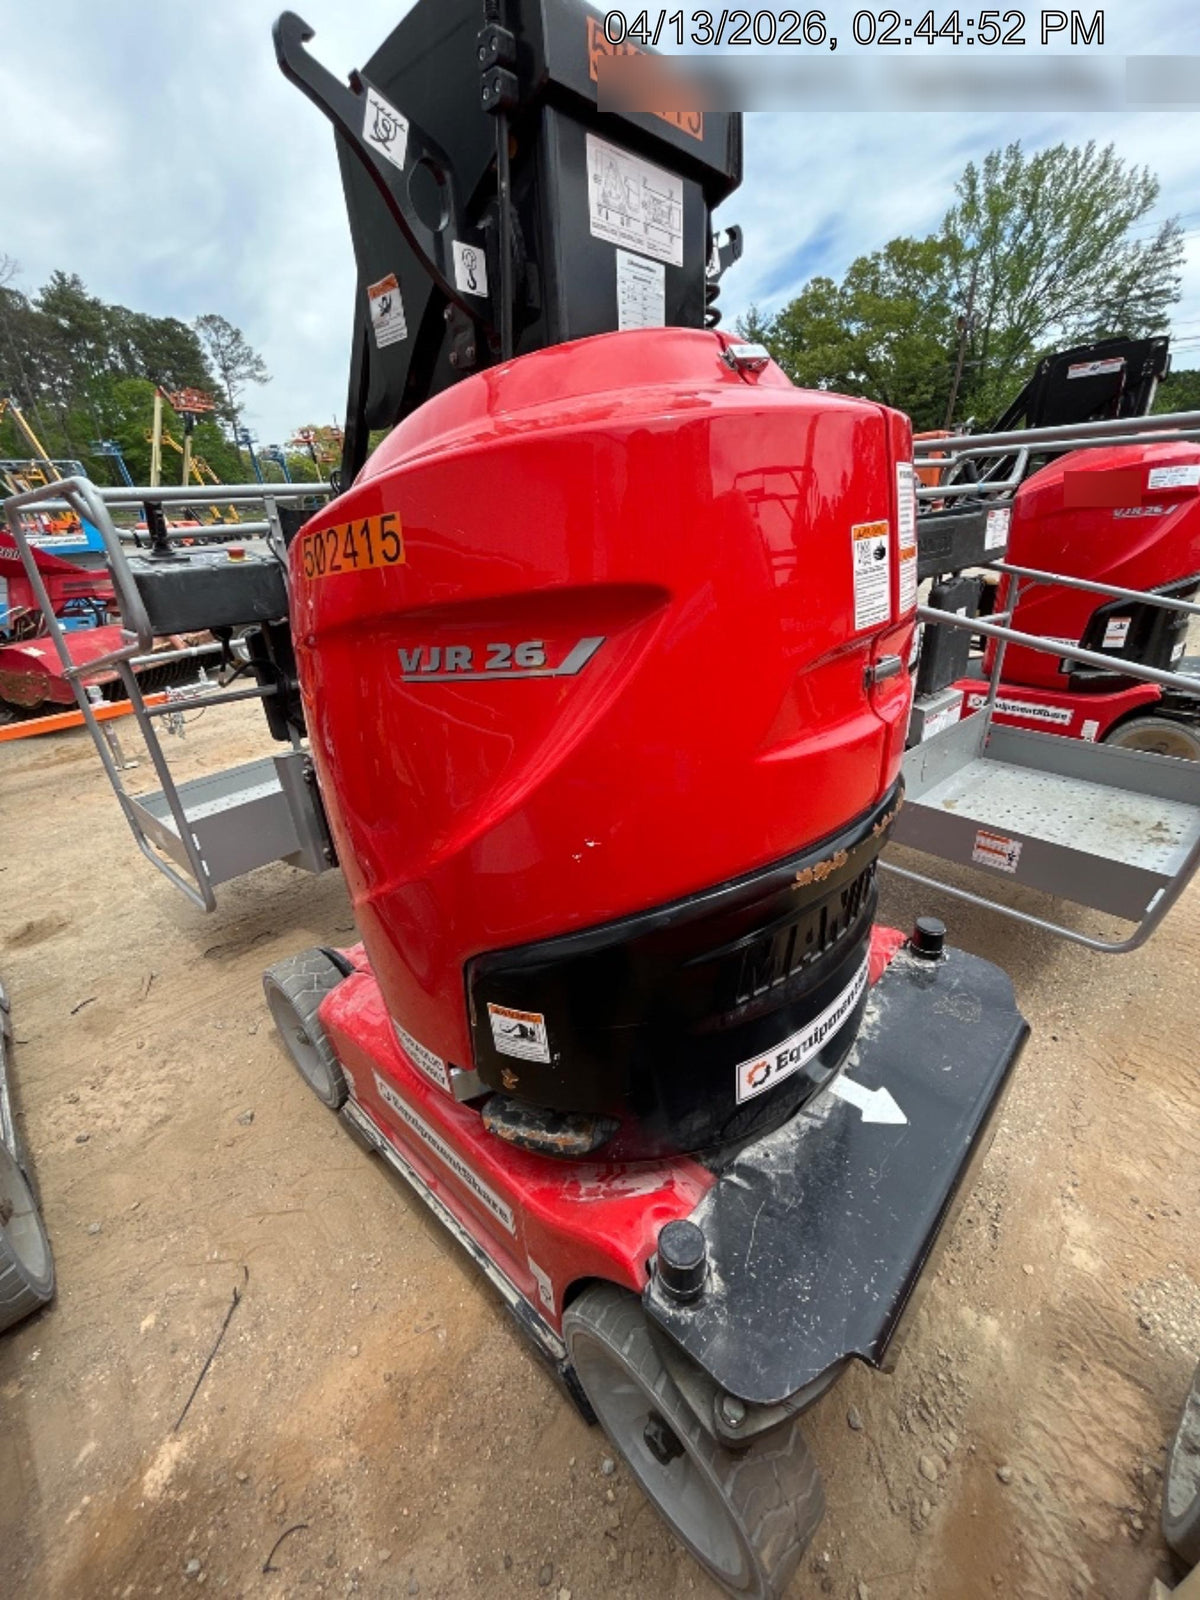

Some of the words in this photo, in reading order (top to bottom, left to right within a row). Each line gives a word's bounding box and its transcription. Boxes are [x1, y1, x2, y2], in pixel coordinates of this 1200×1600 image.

[303, 514, 401, 578] 502415
[398, 645, 476, 673] VJR
[485, 640, 548, 670] 26
